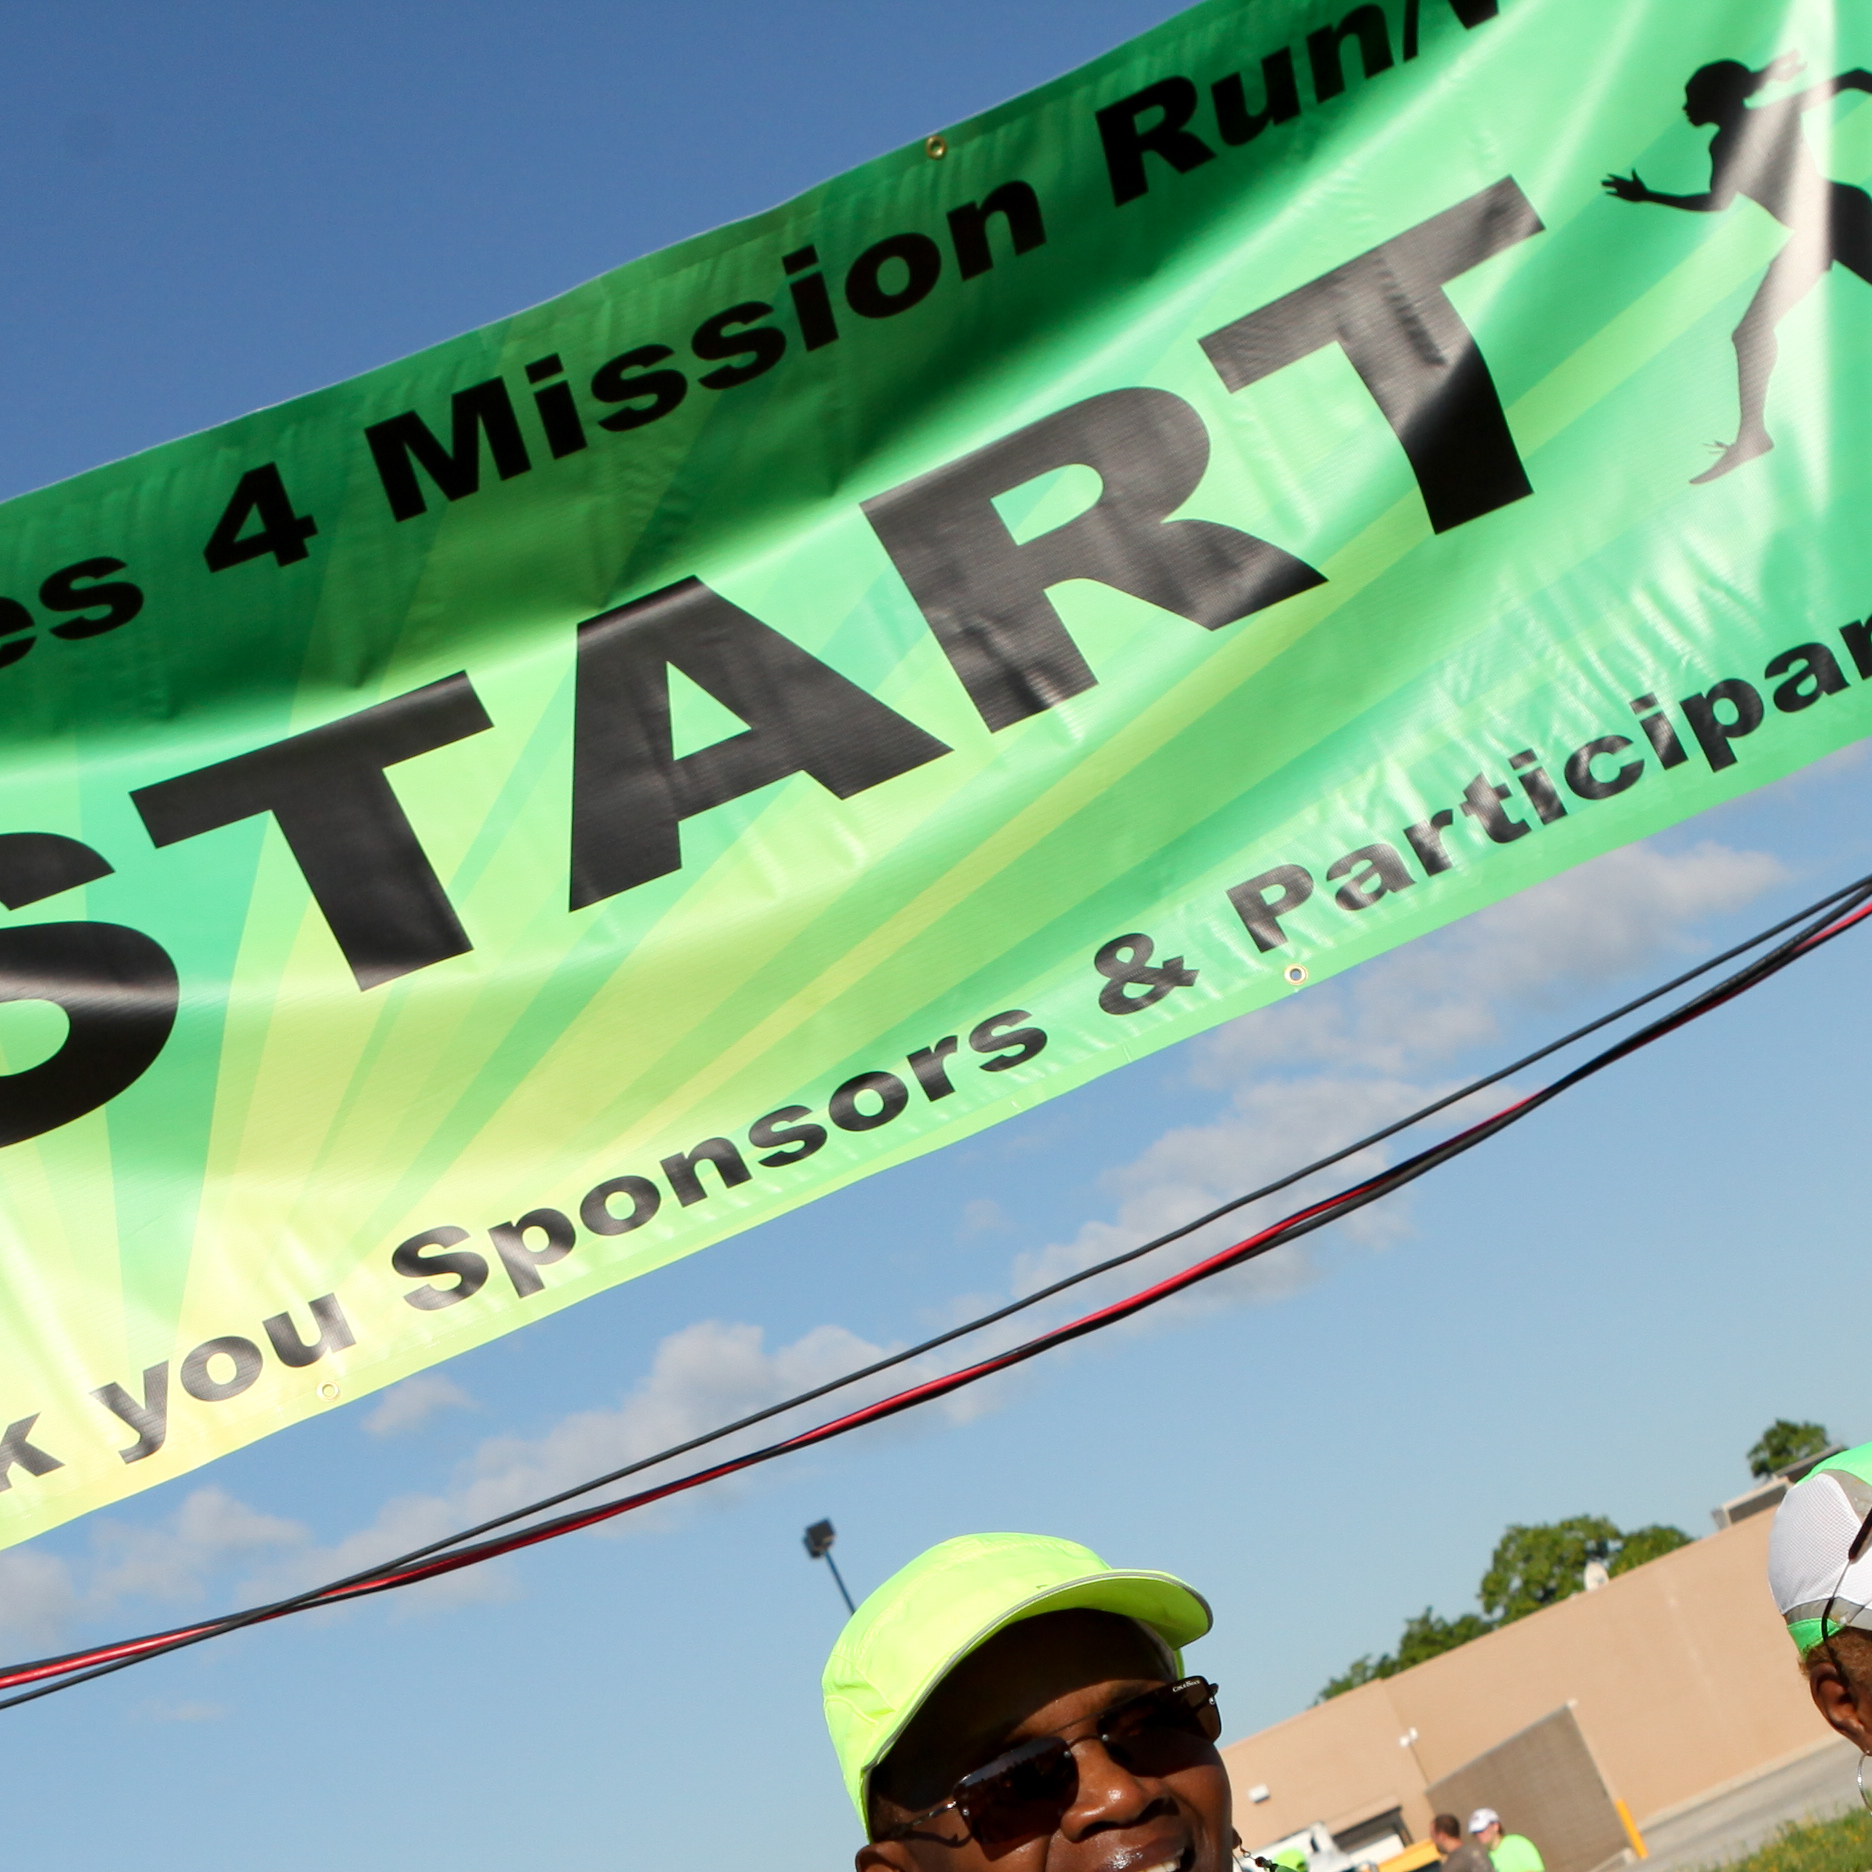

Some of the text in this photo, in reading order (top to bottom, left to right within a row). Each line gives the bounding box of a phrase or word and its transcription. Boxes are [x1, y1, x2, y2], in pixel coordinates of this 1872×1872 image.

[203, 461, 317, 572] 4
[363, 180, 1046, 522] Mission
[1095, 0, 1500, 206] Run/
[89, 1293, 356, 1465] you
[390, 1009, 1048, 1313] Sponsors
[1092, 933, 1200, 1016] &
